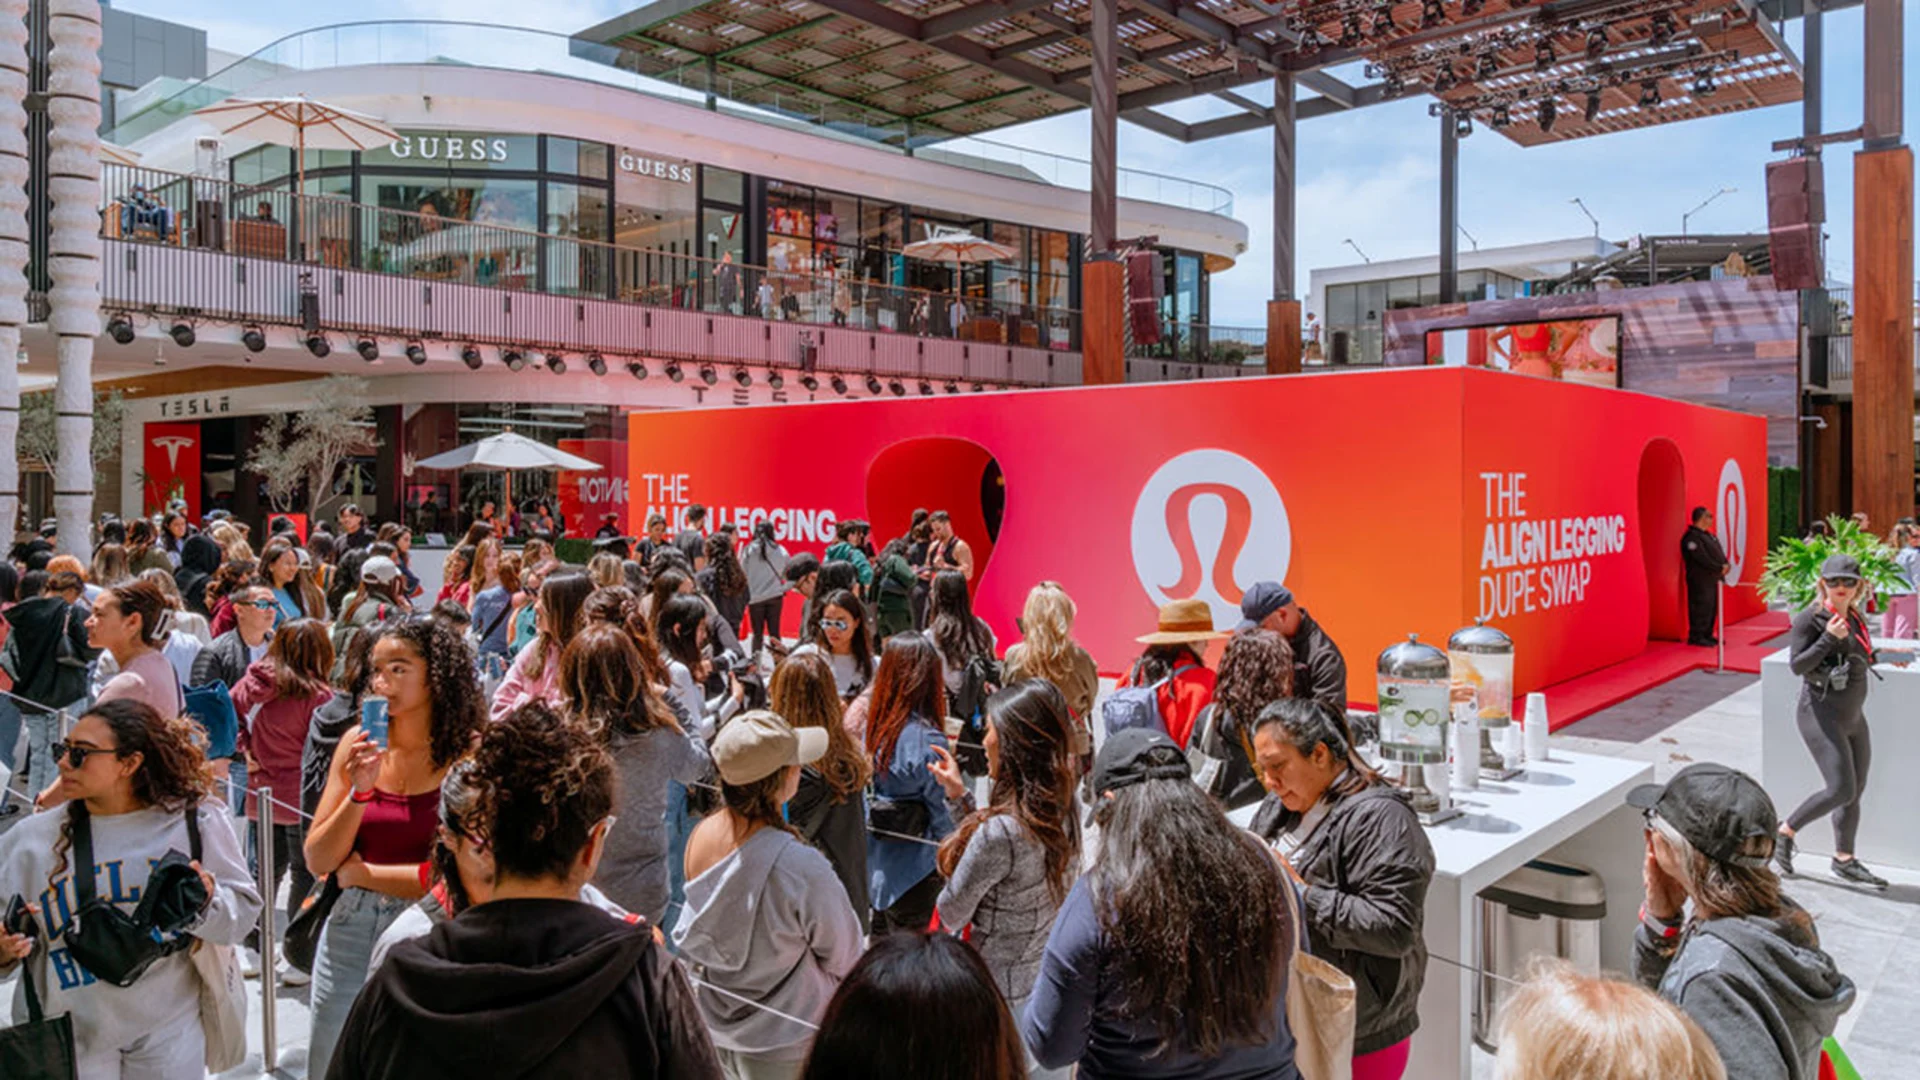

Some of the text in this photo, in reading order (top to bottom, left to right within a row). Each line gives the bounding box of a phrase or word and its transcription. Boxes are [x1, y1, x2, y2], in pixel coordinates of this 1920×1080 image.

[389, 136, 507, 161] GUESS
[619, 154, 692, 183] GUESS
[160, 396, 230, 417] TESLA
[691, 386, 859, 405] TES
[642, 474, 689, 503] THE
[1480, 472, 1526, 518] THE
[1480, 514, 1625, 570] ALIGN LEGGING
[1479, 561, 1591, 622] DUPE SWAP
